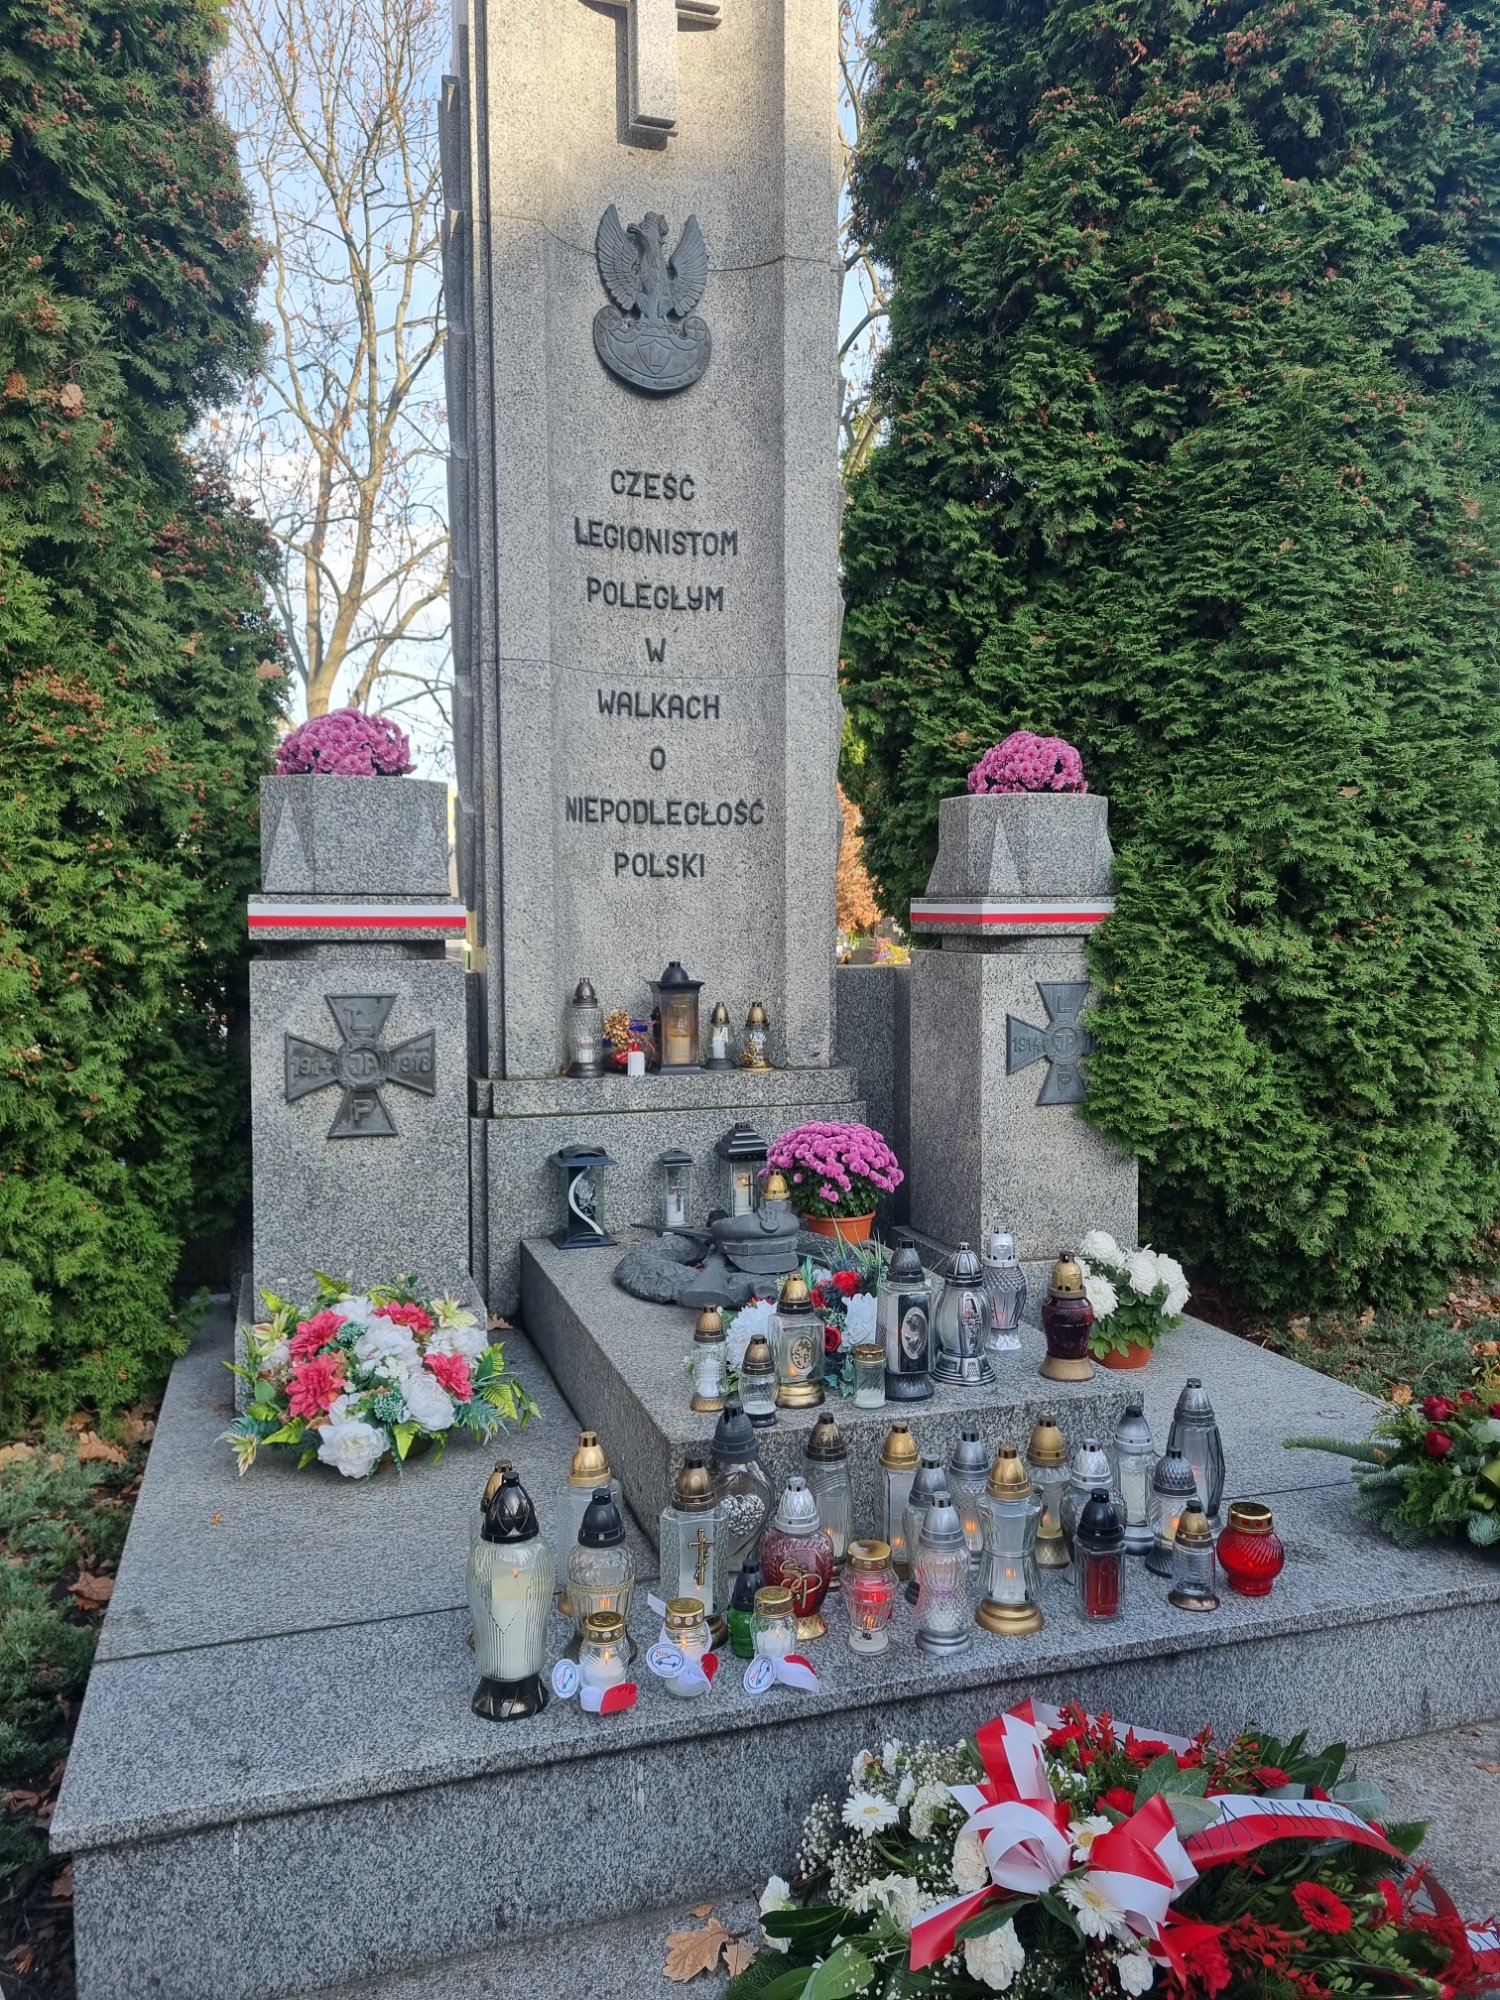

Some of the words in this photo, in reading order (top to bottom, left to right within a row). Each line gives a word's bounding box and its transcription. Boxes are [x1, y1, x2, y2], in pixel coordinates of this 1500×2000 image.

[611, 469, 695, 501] CZEŚĆ
[574, 516, 738, 556] LEGIONISTOM
[587, 576, 724, 611] POLEGŁYM
[646, 637, 666, 662] W
[598, 688, 720, 720] WALKACH
[650, 746, 666, 771] O
[565, 796, 765, 826] NIEPODLEGŁOŚĆ
[613, 852, 706, 878] POLSKI
[1012, 1036, 1041, 1053] 1914
[290, 1056, 333, 1077] 1914
[392, 1053, 432, 1074] 1918
[1057, 1071, 1073, 1091] P
[353, 1099, 375, 1122] P
